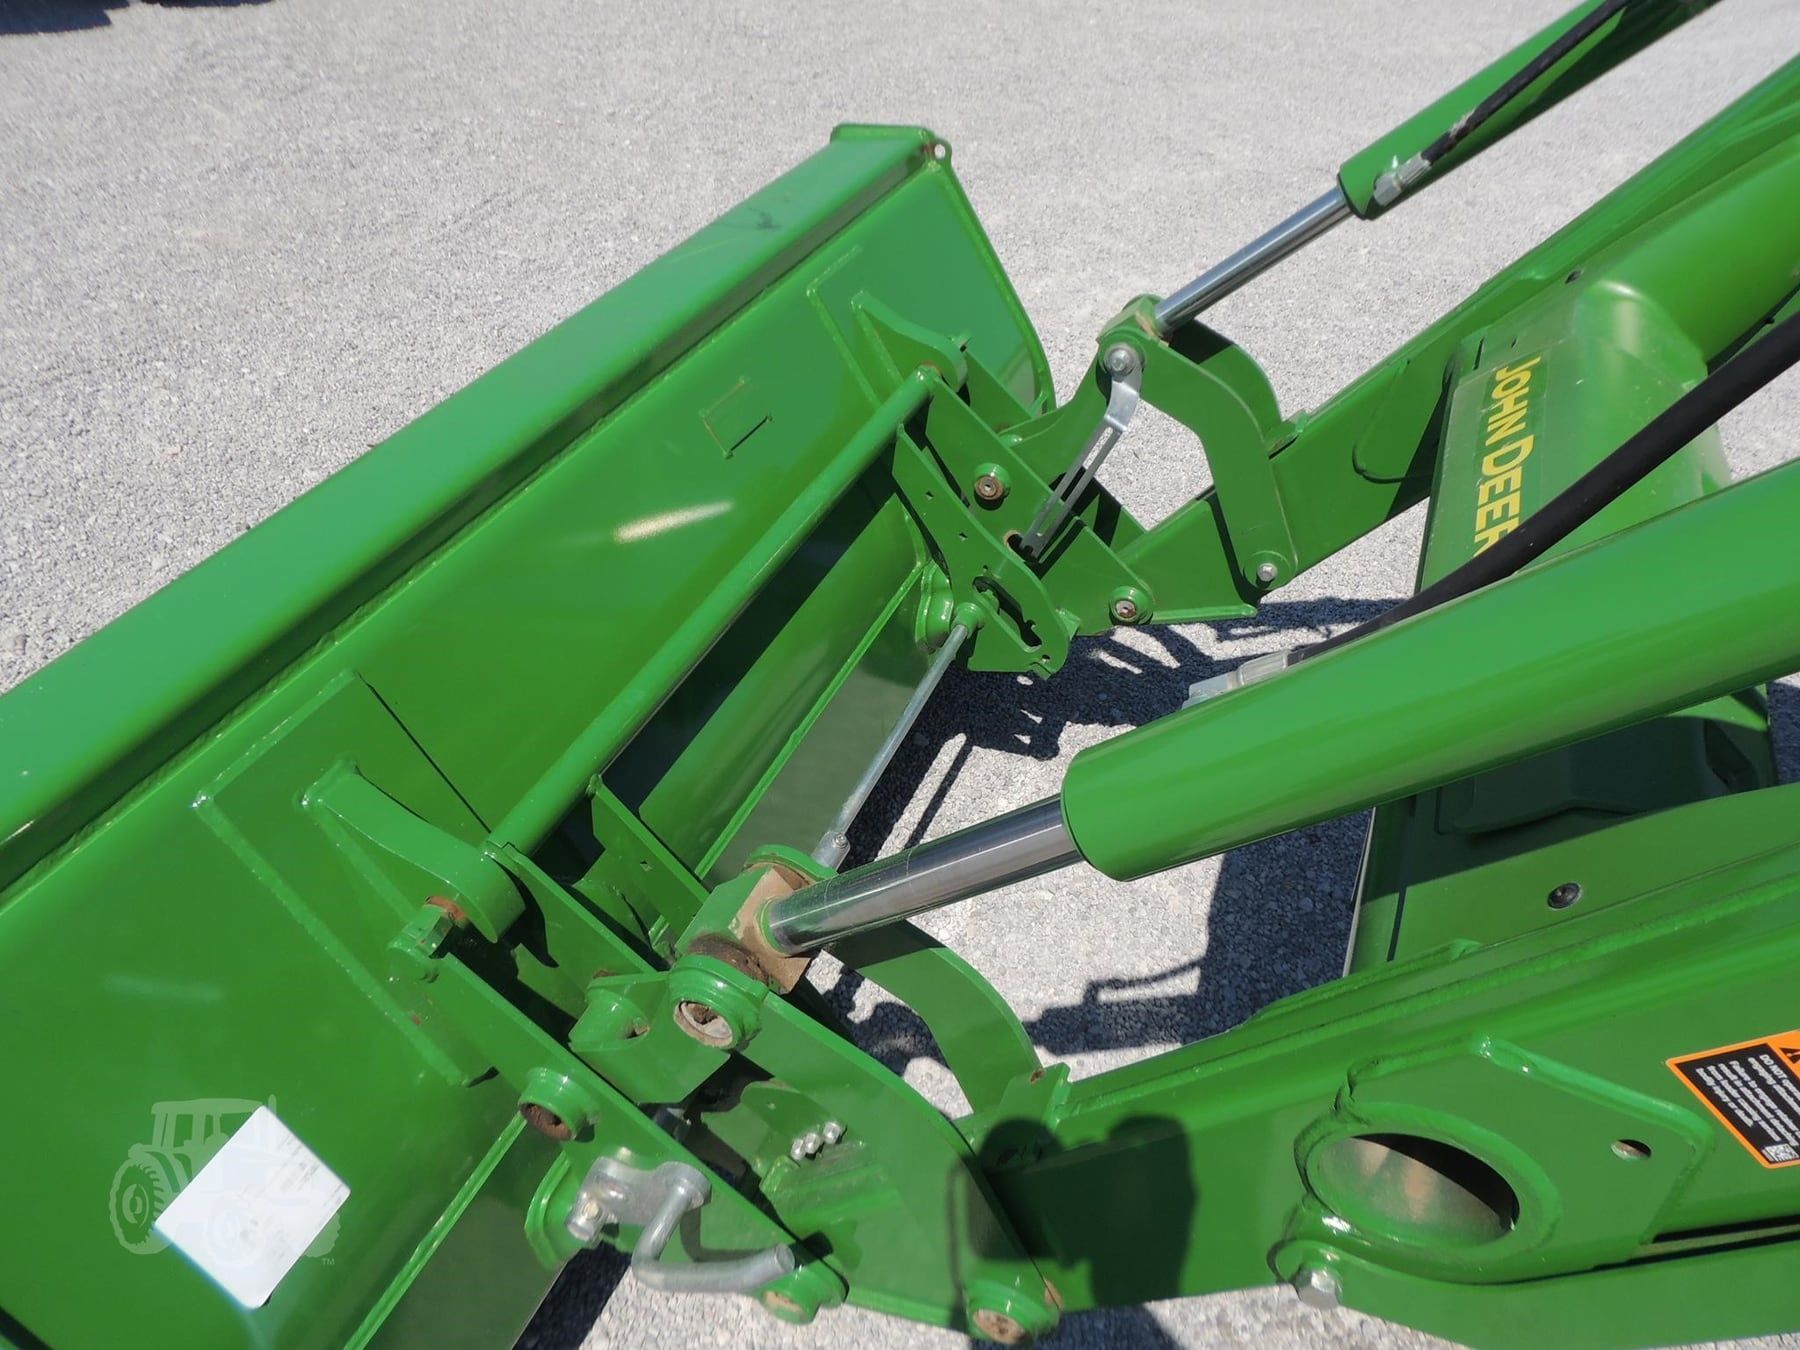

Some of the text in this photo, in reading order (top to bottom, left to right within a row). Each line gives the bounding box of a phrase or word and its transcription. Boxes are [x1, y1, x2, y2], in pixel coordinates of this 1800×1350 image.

[1473, 356, 1542, 558] JOHN DEER
[1759, 1054, 1774, 1066] DO
[1769, 1064, 1788, 1079] NOT
